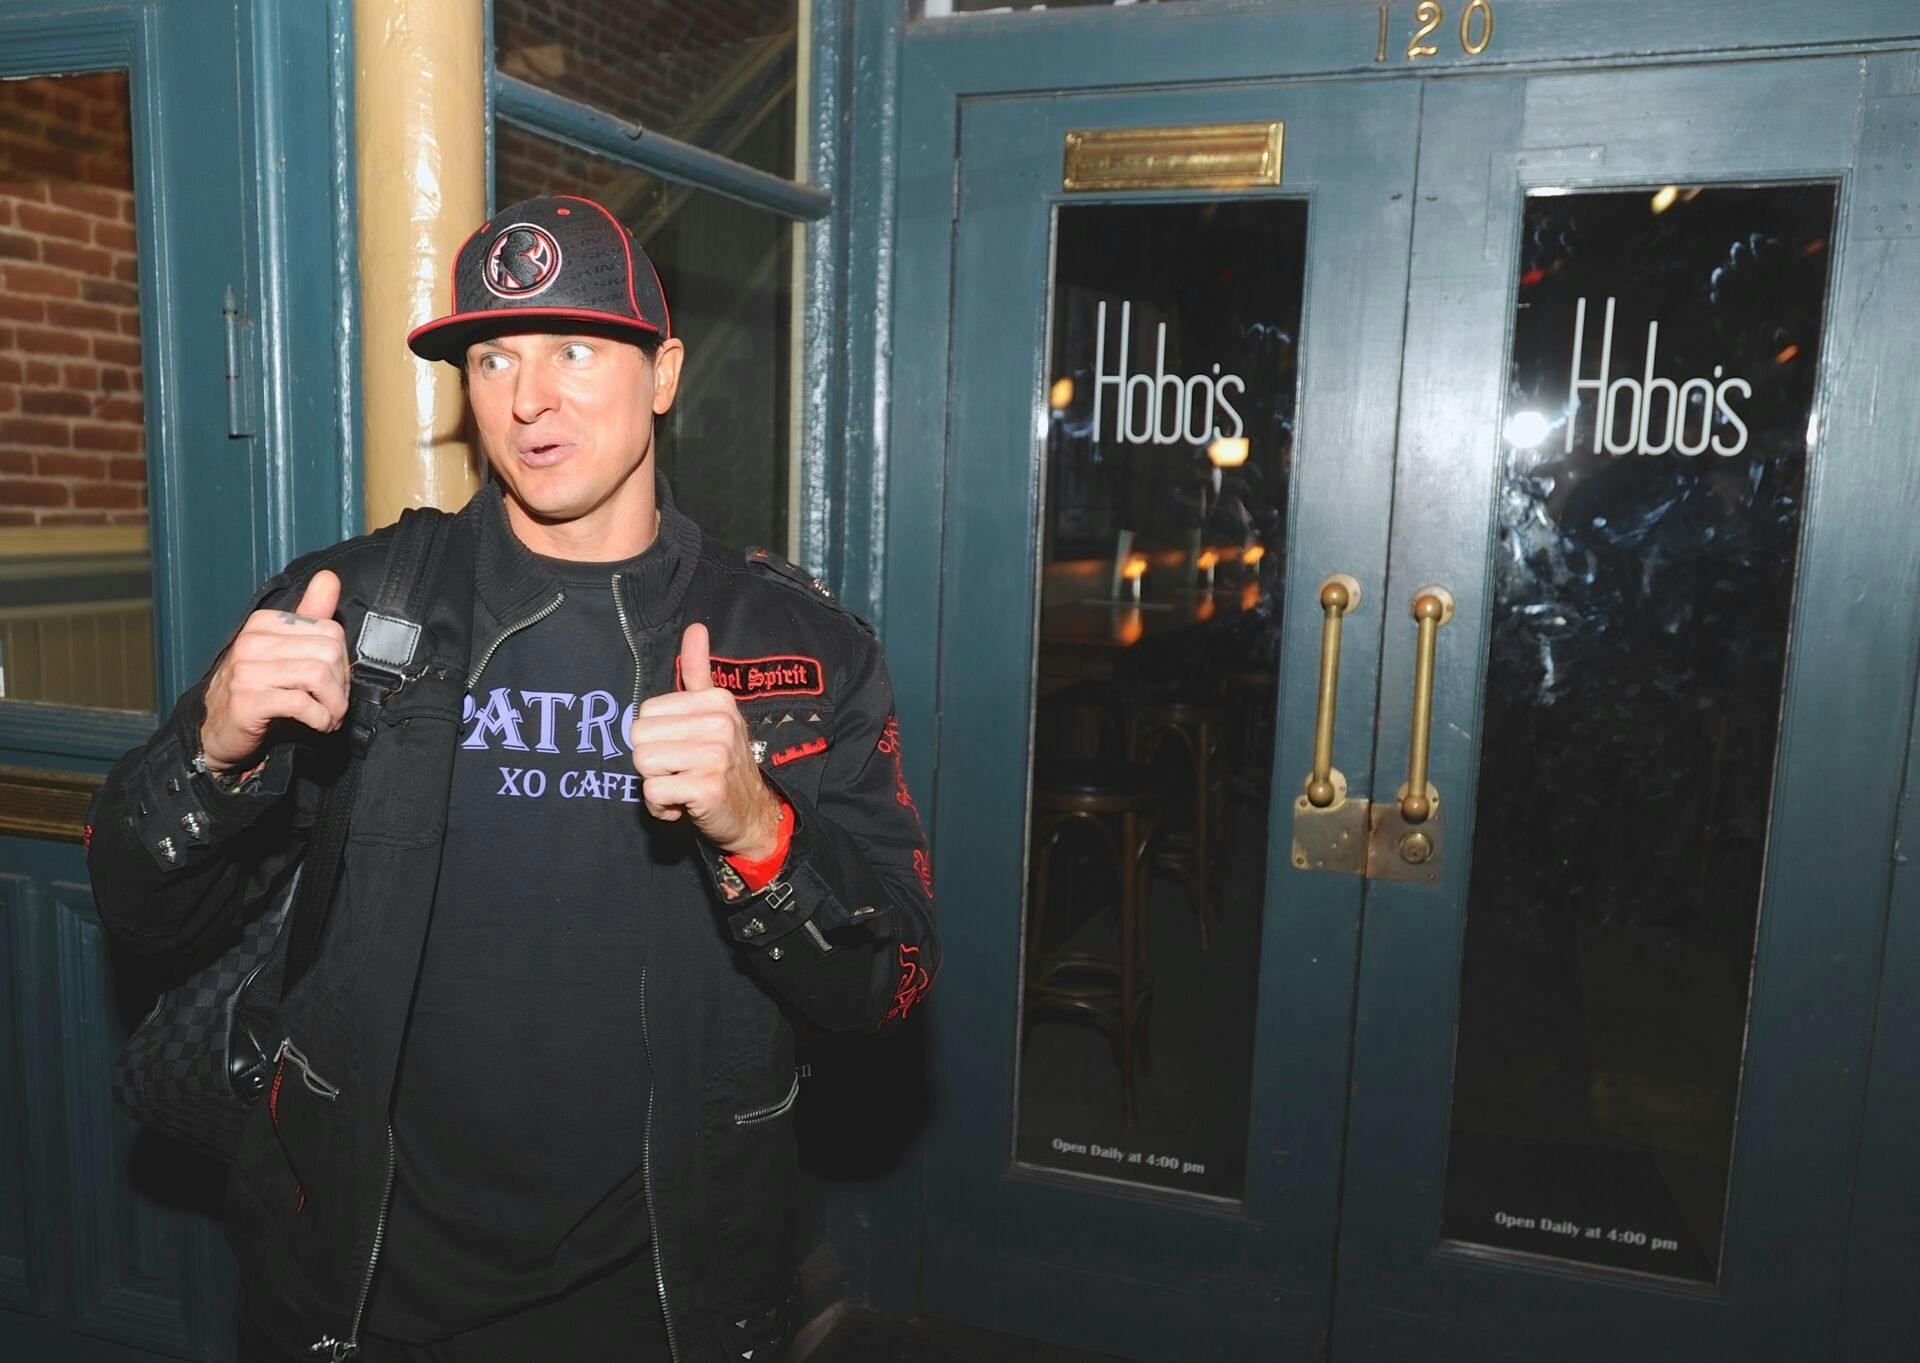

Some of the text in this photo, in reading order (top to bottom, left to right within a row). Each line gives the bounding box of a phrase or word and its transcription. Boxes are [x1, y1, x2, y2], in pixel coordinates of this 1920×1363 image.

[1374, 0, 1493, 62] 120
[1092, 300, 1246, 446] Hobo's
[1564, 296, 1752, 457] Hobo's
[710, 664, 808, 691] ebel Spirit
[497, 766, 548, 798] XO
[1052, 1137, 1206, 1173] Open Daily at 4:00 pm
[1494, 1211, 1679, 1250] Open Daily at 4:00 pm
